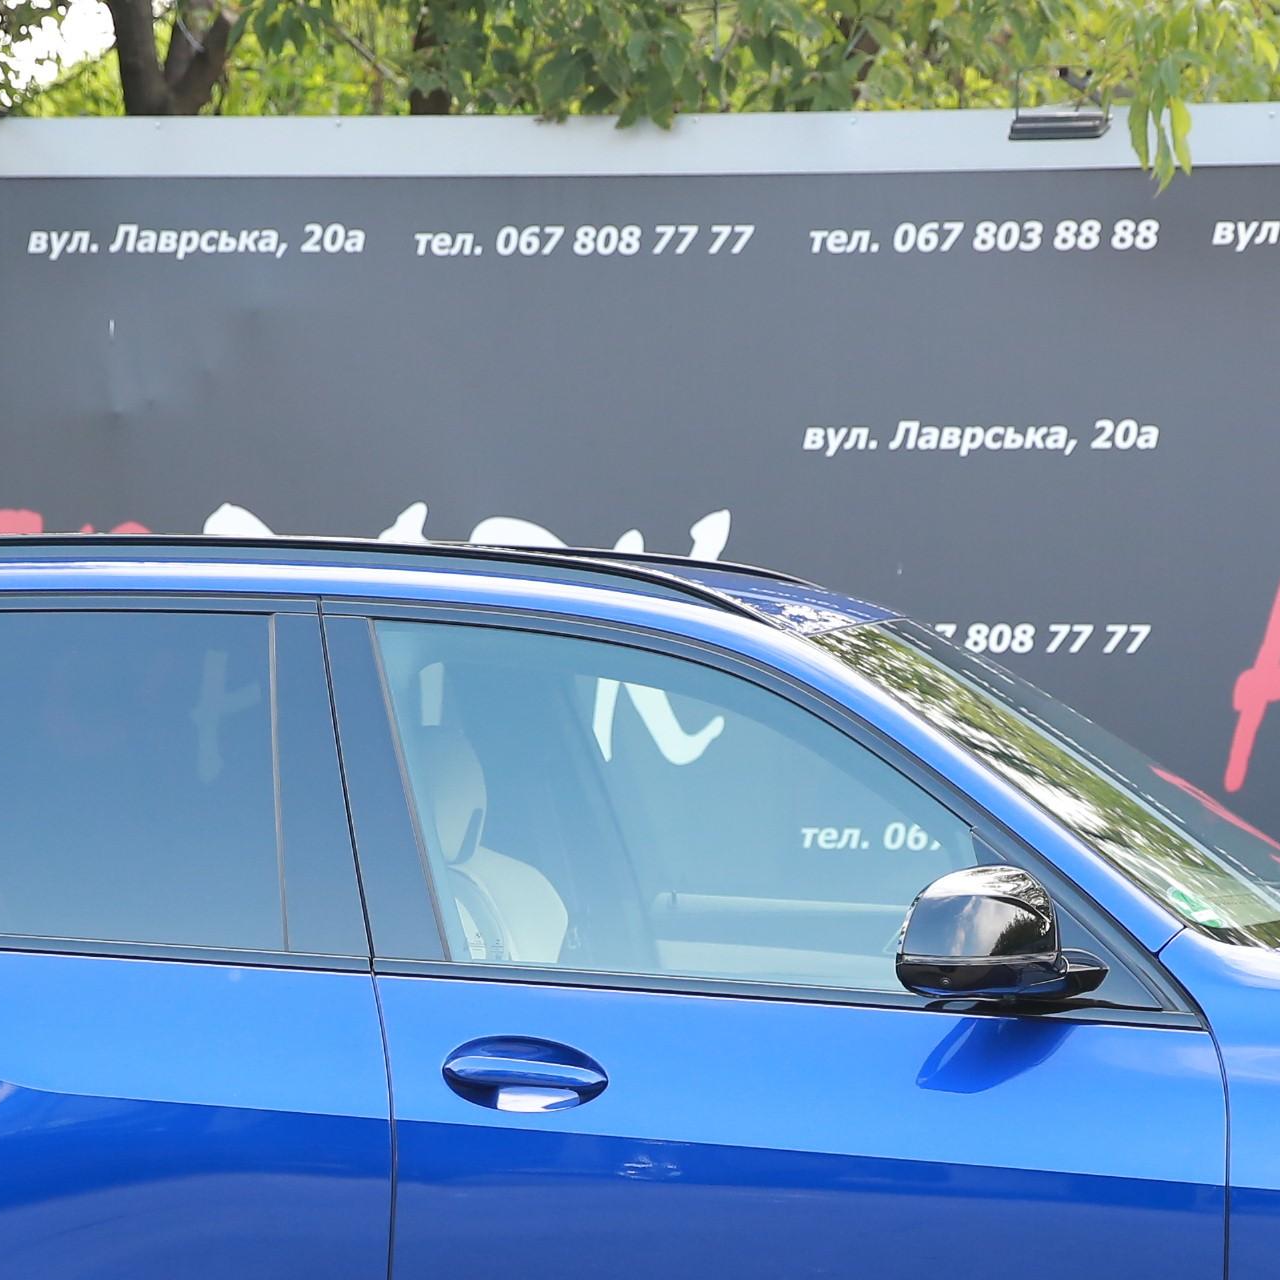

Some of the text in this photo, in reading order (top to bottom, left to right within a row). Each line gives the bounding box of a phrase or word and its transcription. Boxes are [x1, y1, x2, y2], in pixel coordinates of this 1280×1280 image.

[28, 223, 366, 260] вул. Лаврська, 20а
[414, 225, 755, 256] тел. 067 808 77 77
[809, 219, 1159, 254] тел. 067 803 88 88
[803, 419, 1159, 457] вул. Лаврська, 20а
[964, 623, 1036, 654] 808
[1046, 624, 1094, 653] 77
[1103, 624, 1151, 654] 77
[801, 822, 942, 851] тел. 06
